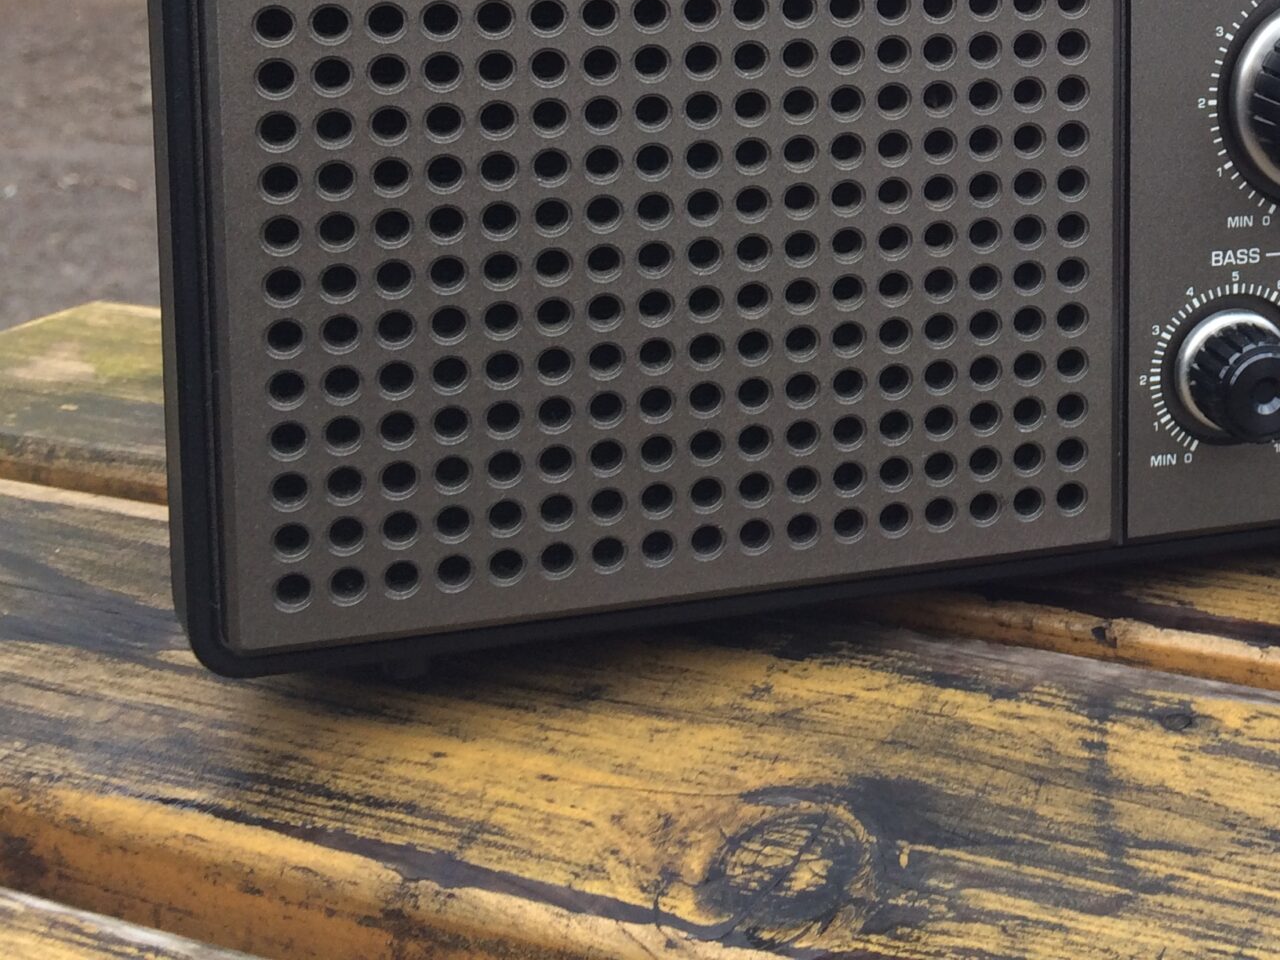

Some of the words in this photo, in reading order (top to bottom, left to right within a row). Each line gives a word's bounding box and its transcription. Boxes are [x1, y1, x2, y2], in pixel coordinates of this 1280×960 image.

[1215, 26, 1224, 37] 3
[1198, 98, 1206, 109] 2
[1216, 167, 1223, 177] 1
[1227, 215, 1254, 228] MIN
[1262, 215, 1270, 226] 0
[1211, 248, 1260, 267] BASS
[1232, 271, 1239, 281] 5
[1186, 287, 1194, 297] 4
[1152, 325, 1160, 335] 3
[1139, 375, 1148, 385] 2
[1150, 454, 1177, 467] MIN
